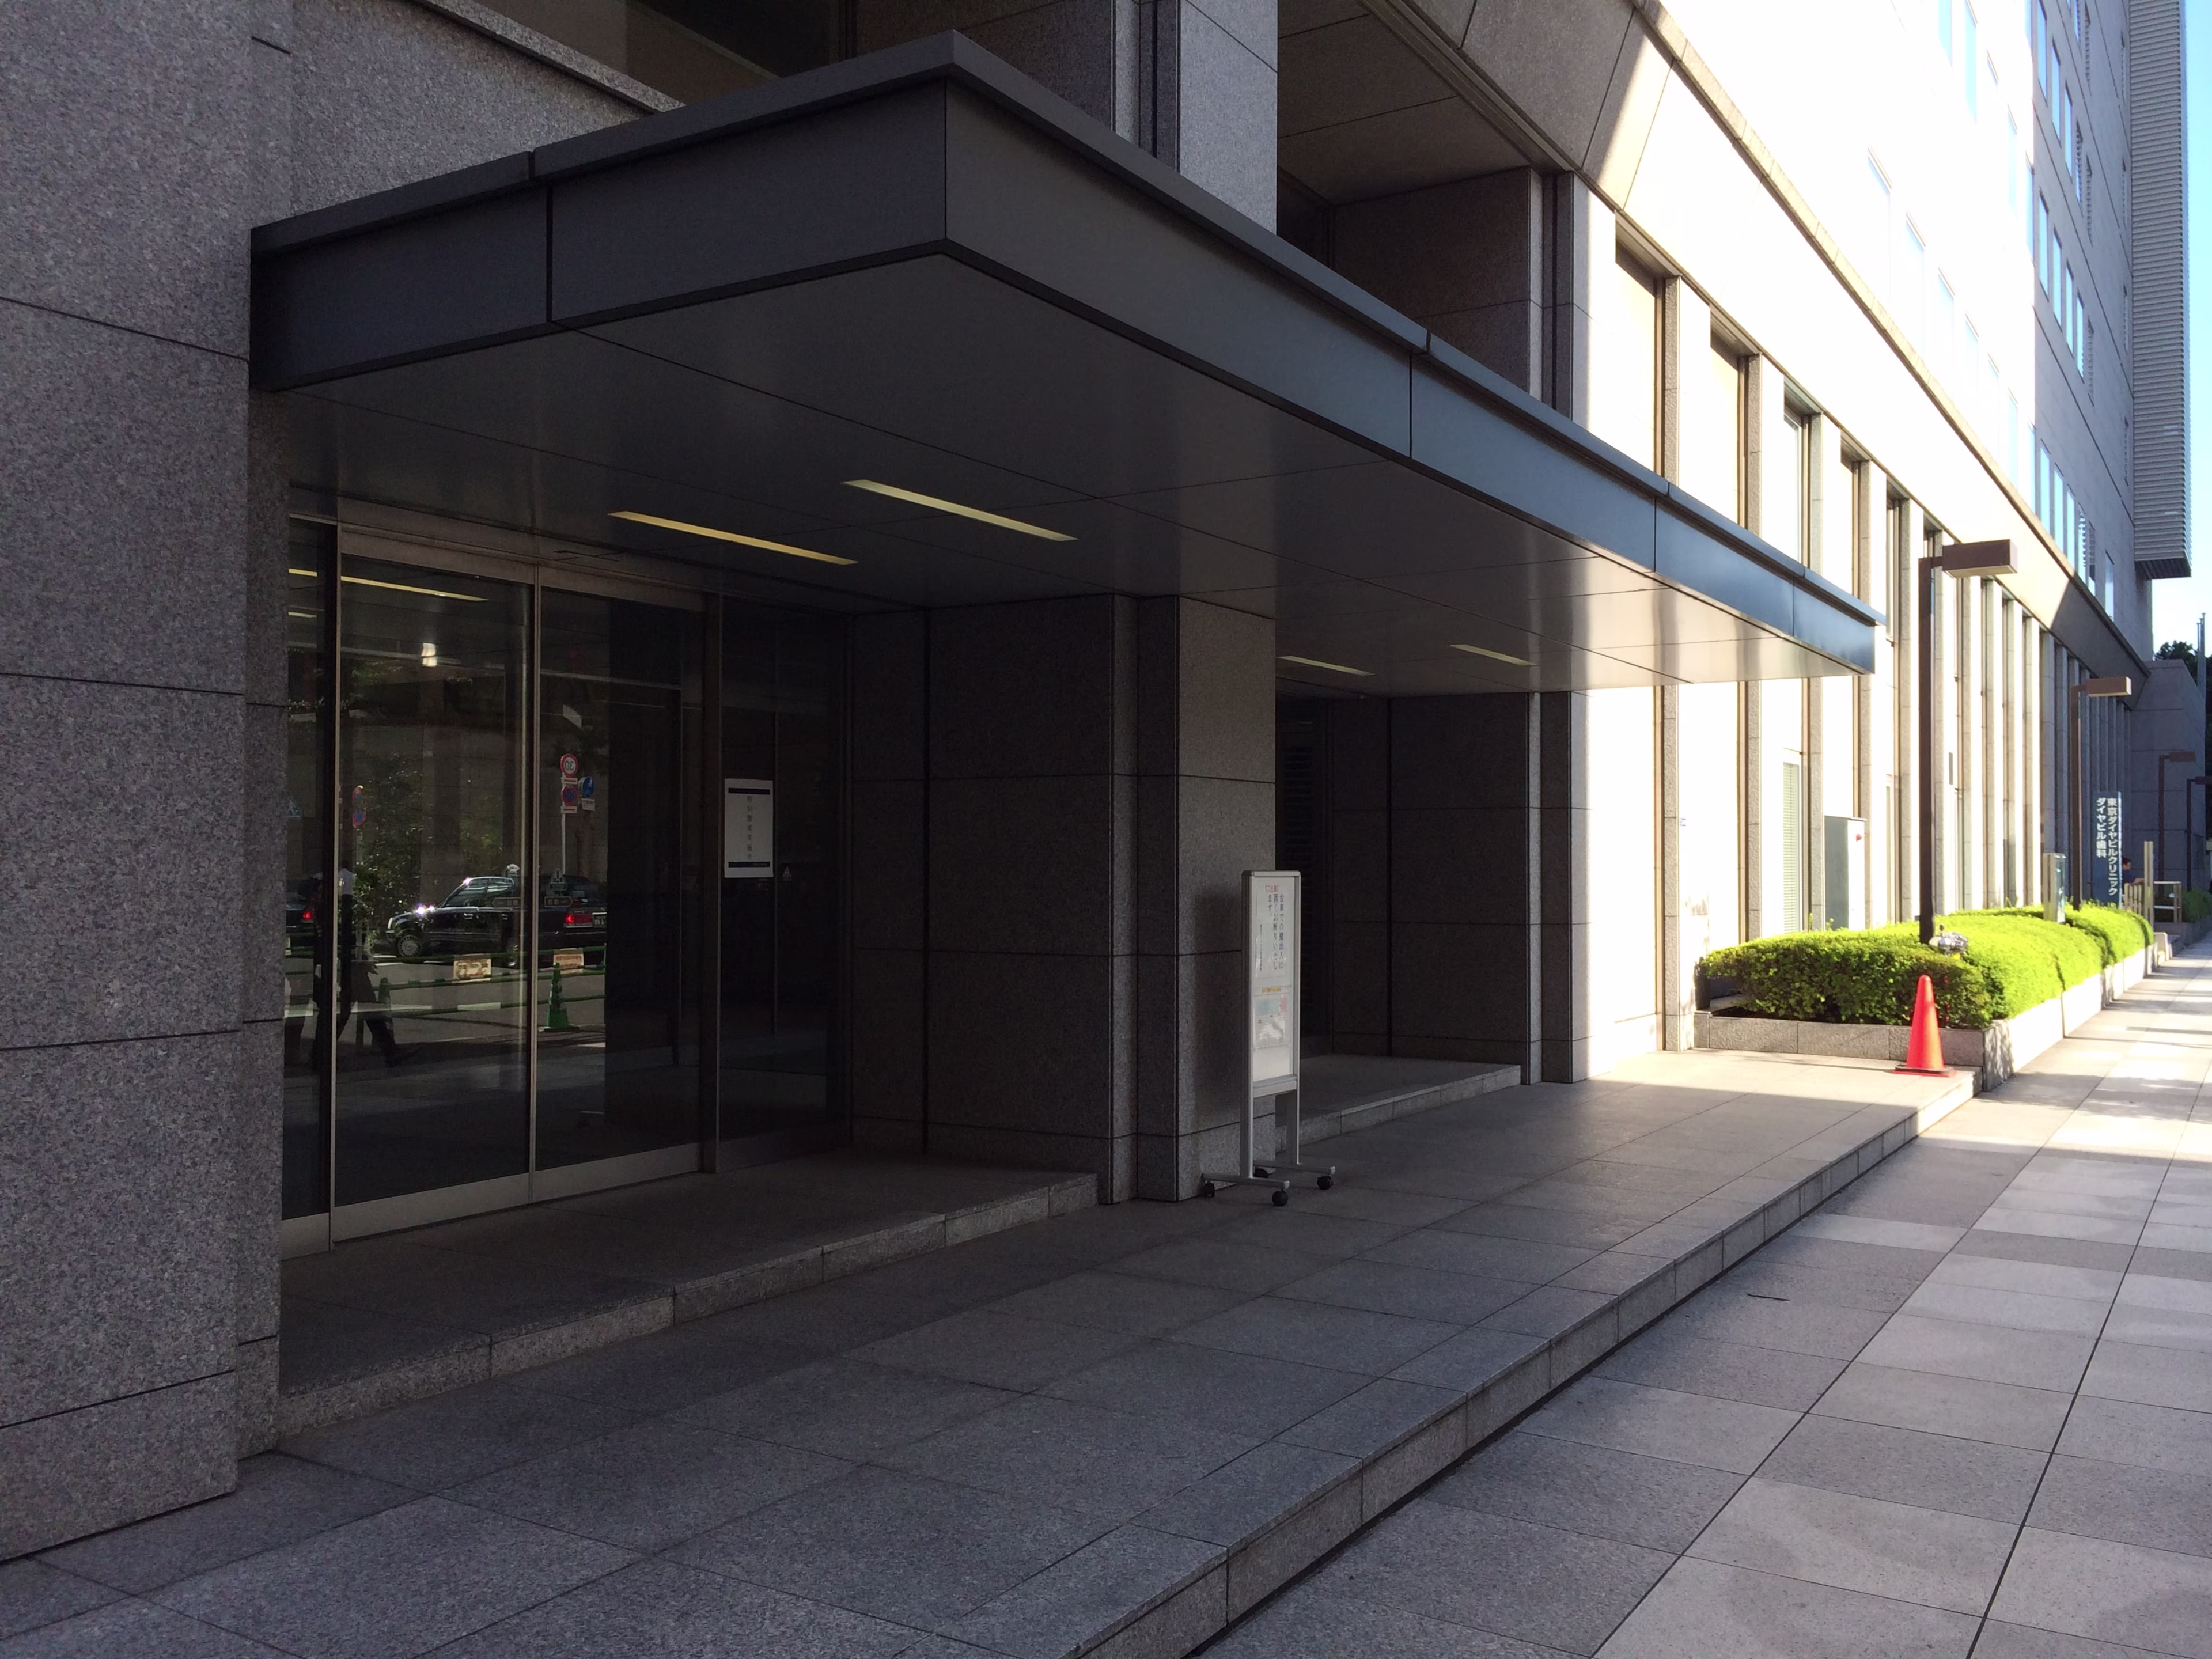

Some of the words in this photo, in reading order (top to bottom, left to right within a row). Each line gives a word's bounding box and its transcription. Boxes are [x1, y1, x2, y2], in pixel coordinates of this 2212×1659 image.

[2096, 797, 2107, 858] ダイヤビル歯科
[2107, 797, 2118, 896] 東京ダイヤビルクリニック
